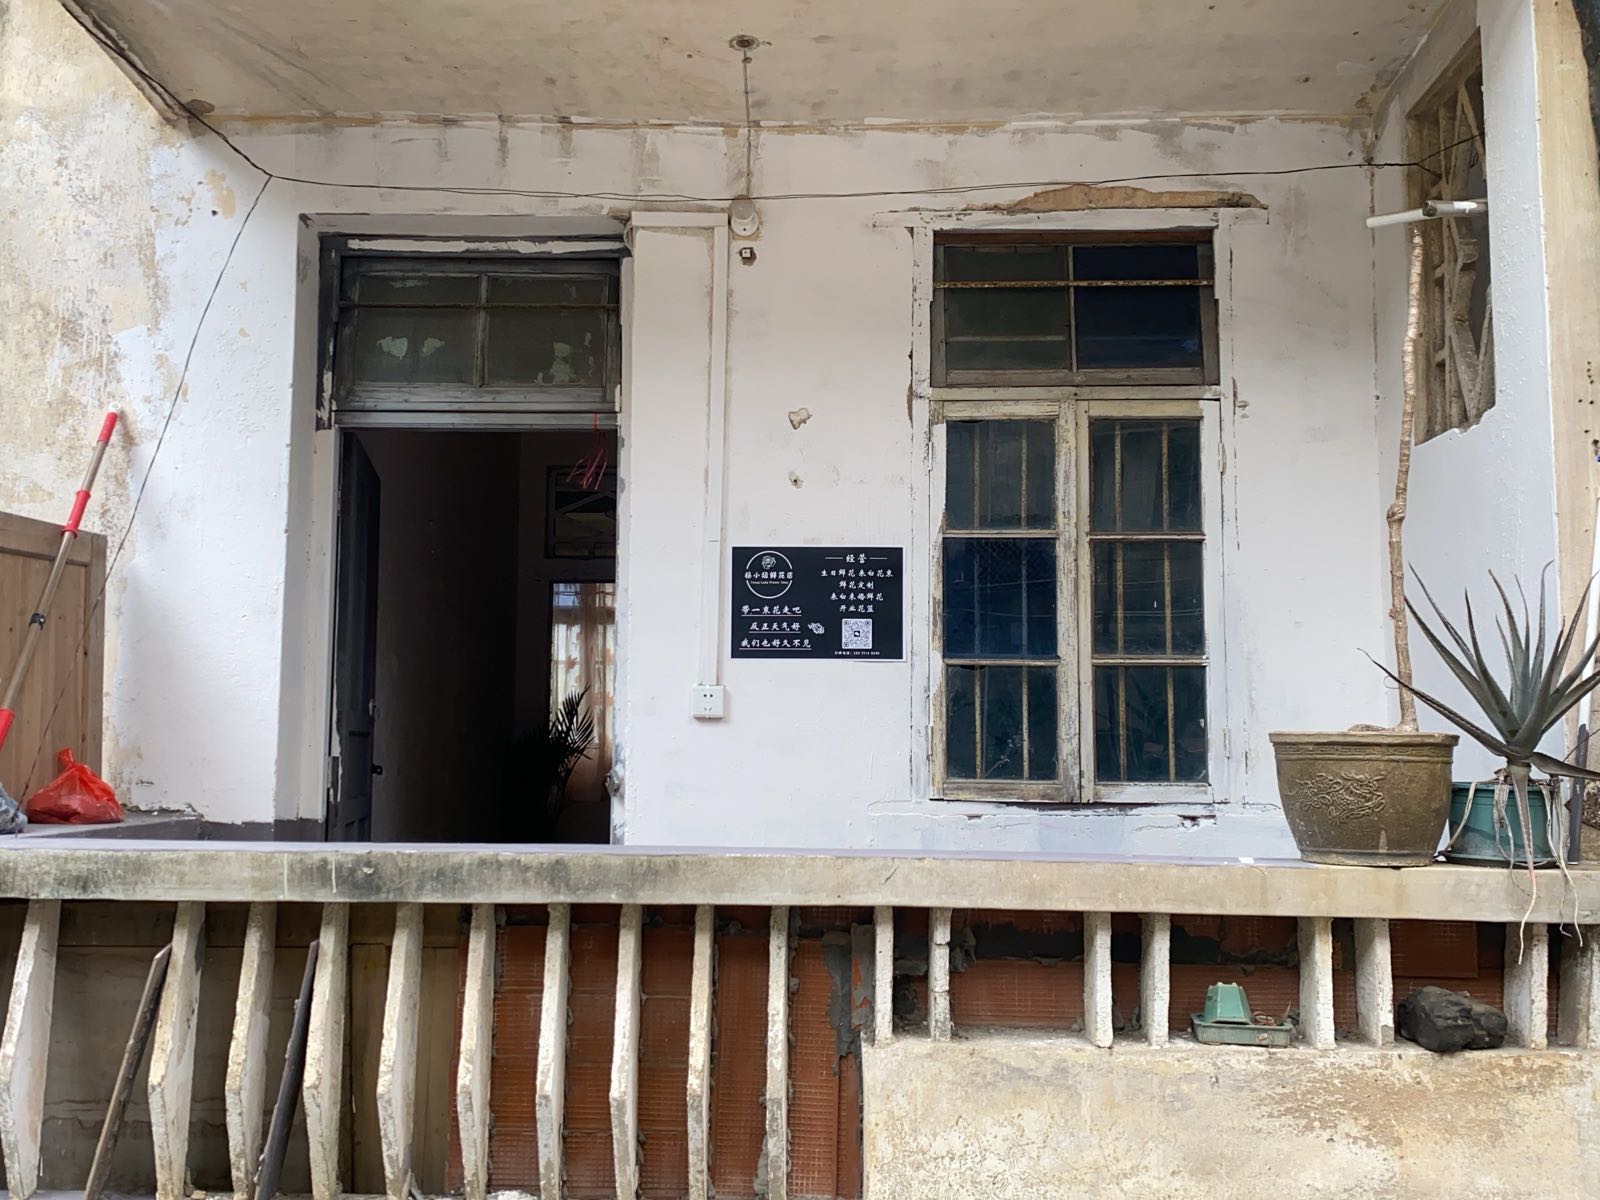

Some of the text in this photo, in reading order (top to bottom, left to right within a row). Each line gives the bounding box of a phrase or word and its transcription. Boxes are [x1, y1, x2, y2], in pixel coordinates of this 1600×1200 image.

[845, 553, 867, 563] 经营
[839, 580, 874, 589] 鲜花定制
[741, 604, 802, 614] 带一束花走吧
[840, 604, 874, 613] 开业花篮
[749, 621, 801, 632] 反正天气好
[741, 637, 811, 648] 我们也好久不见
